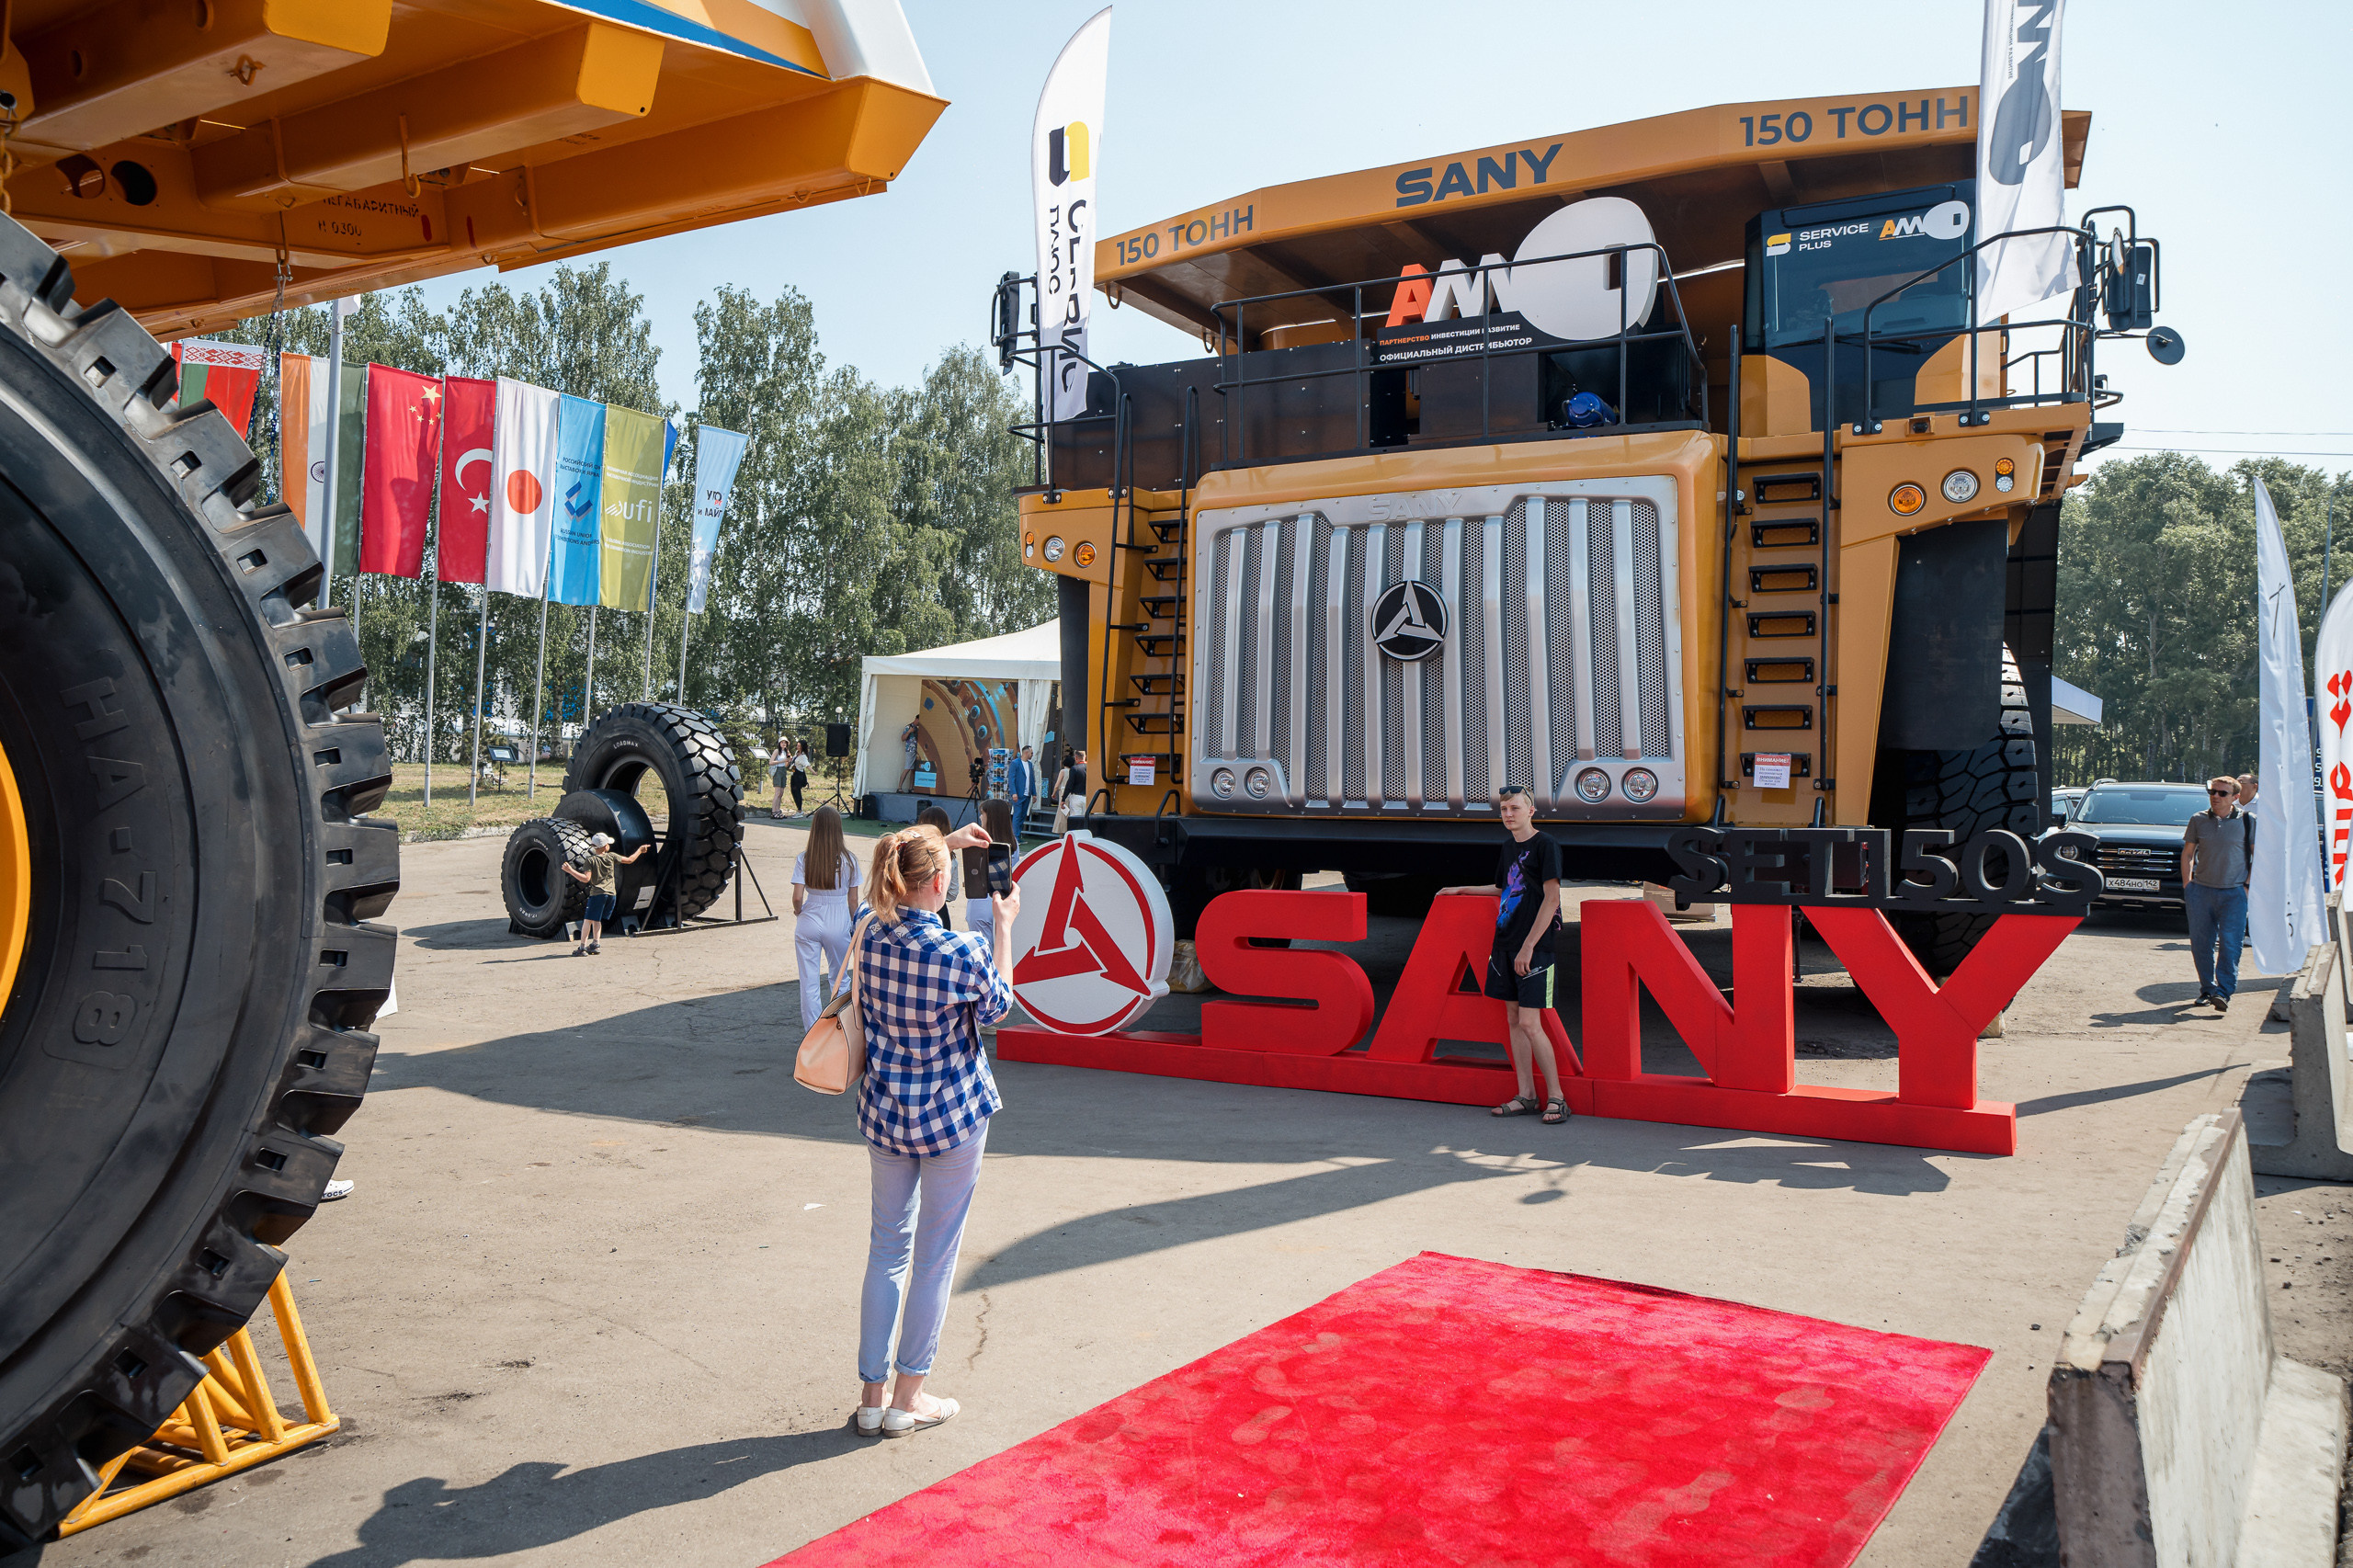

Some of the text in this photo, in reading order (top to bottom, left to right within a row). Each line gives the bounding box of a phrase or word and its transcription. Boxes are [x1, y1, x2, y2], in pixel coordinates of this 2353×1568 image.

[1740, 96, 1968, 147] 150 ТОНН
[1395, 142, 1564, 208] SANY
[1116, 204, 1254, 267] 150 ТОНН
[1799, 222, 1870, 242] SERVICE
[1799, 240, 1832, 252] PLUS
[1379, 335, 1430, 347] ПАРТНЕРСТВО
[1430, 328, 1481, 340] ИНВЕСТИЦИИ
[1379, 345, 1453, 362] ОФИЦИАЛЬНЫЙ
[623, 499, 653, 523] ufi
[1368, 494, 1462, 521] SANY
[1195, 889, 2086, 1110] SANY
